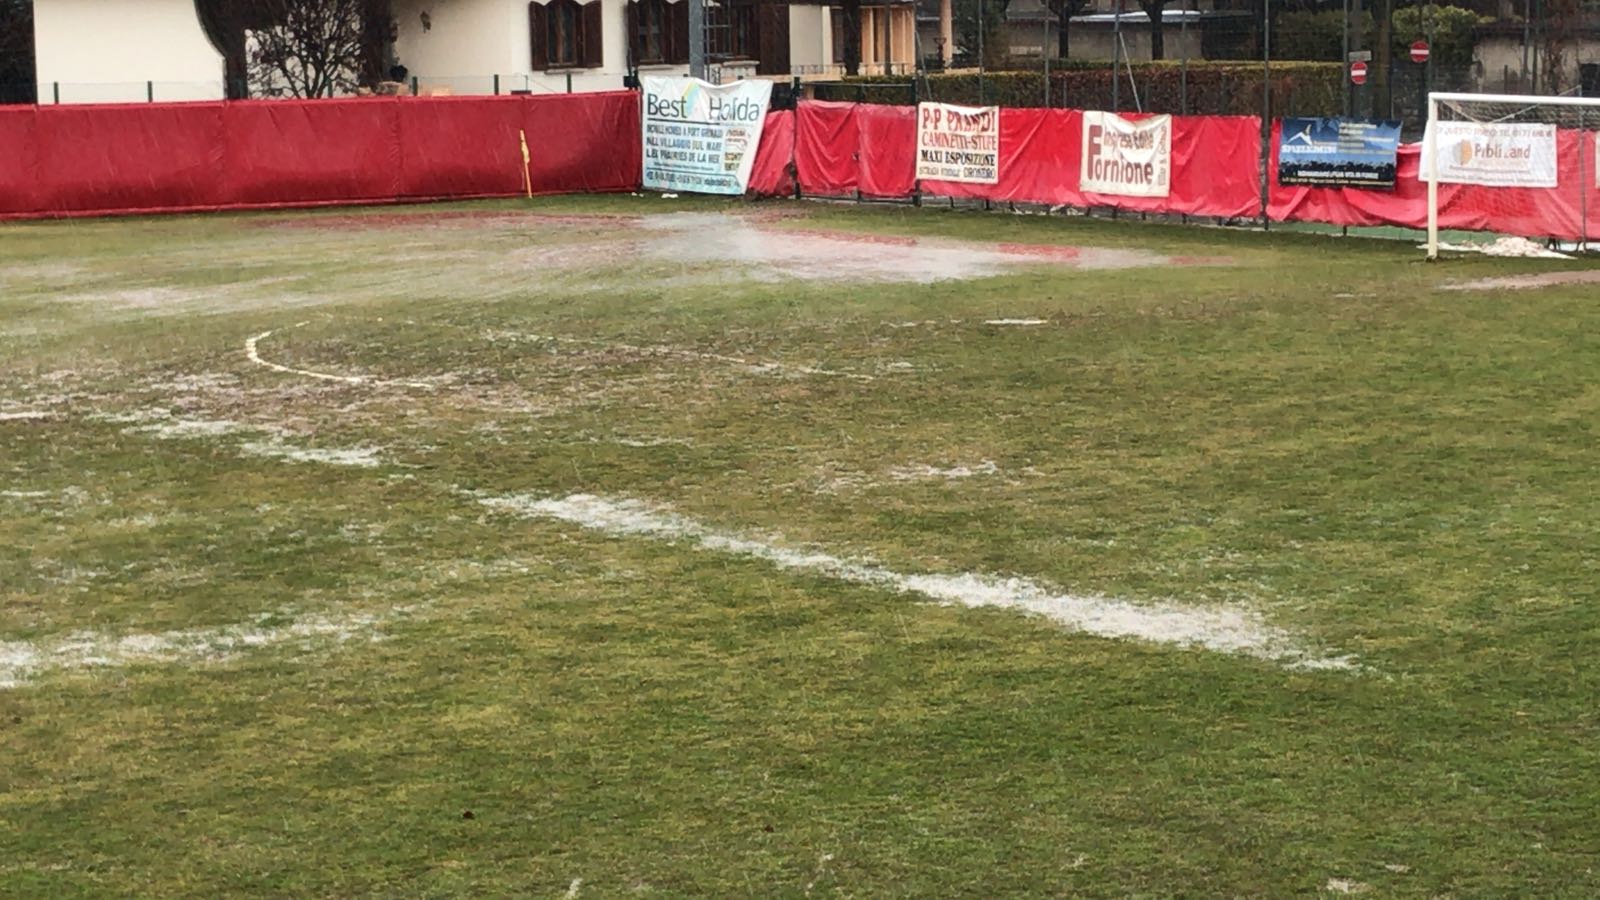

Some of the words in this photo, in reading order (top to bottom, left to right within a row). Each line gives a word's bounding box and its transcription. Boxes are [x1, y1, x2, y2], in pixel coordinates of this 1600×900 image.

[647, 93, 687, 119] Best
[697, 152, 706, 163] LA
[921, 149, 943, 163] MAXI
[1087, 125, 1154, 185] Fornione
